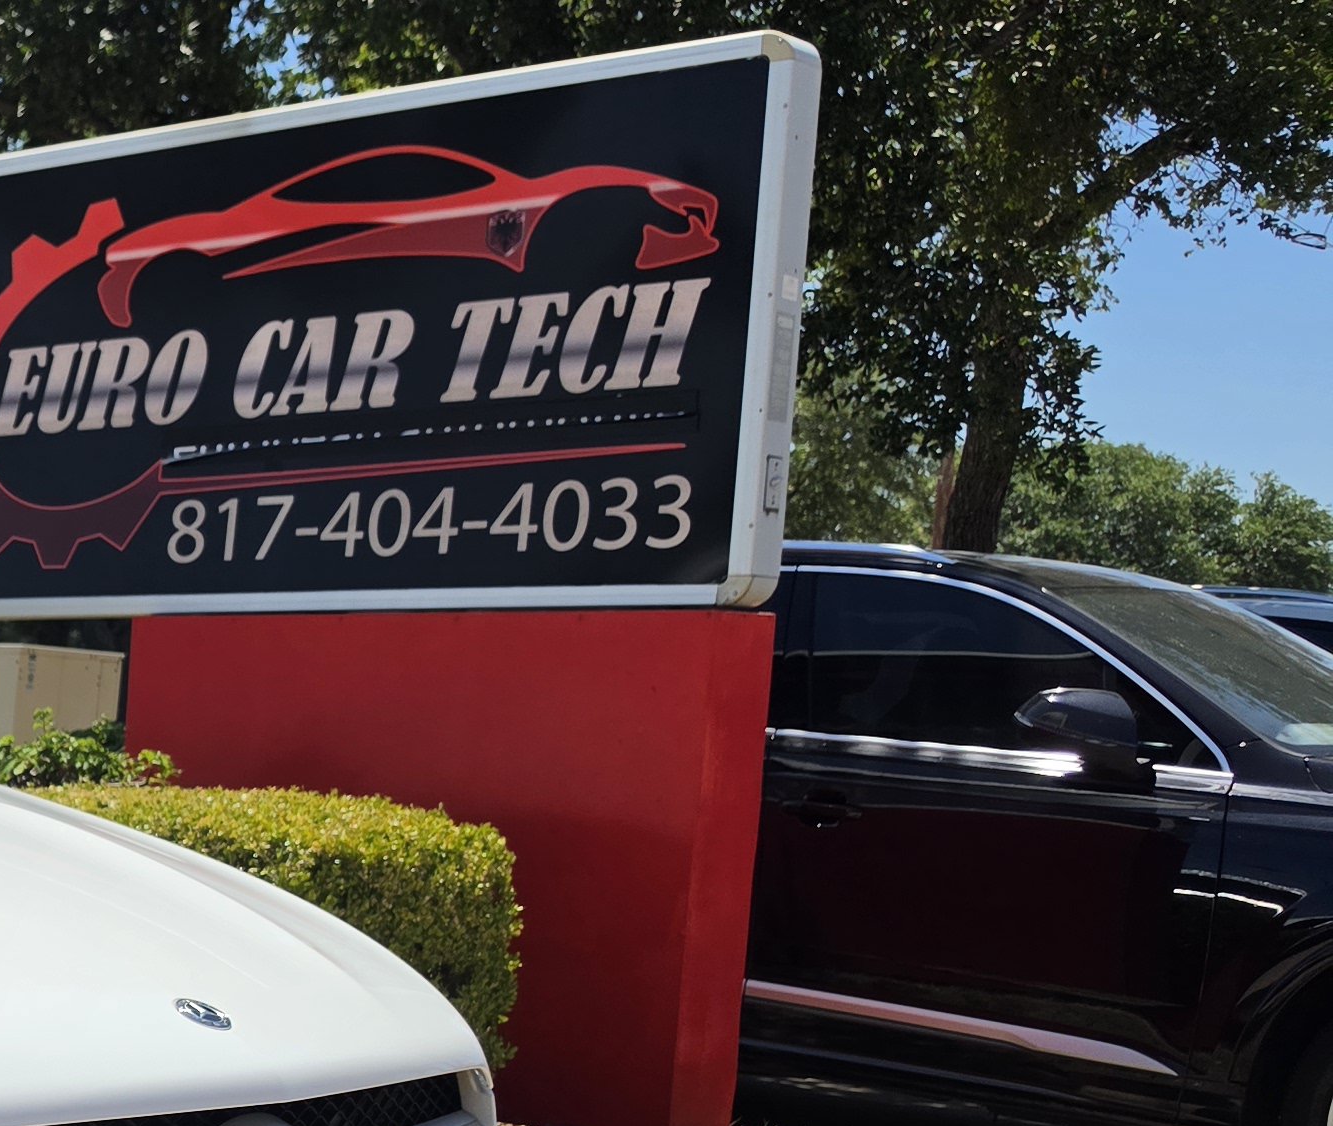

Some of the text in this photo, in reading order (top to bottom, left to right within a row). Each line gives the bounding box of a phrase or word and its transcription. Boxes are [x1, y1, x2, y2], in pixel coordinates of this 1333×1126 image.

[233, 309, 416, 419] CAR
[439, 277, 712, 403] TECH
[166, 474, 692, 564] 817-404-4033
